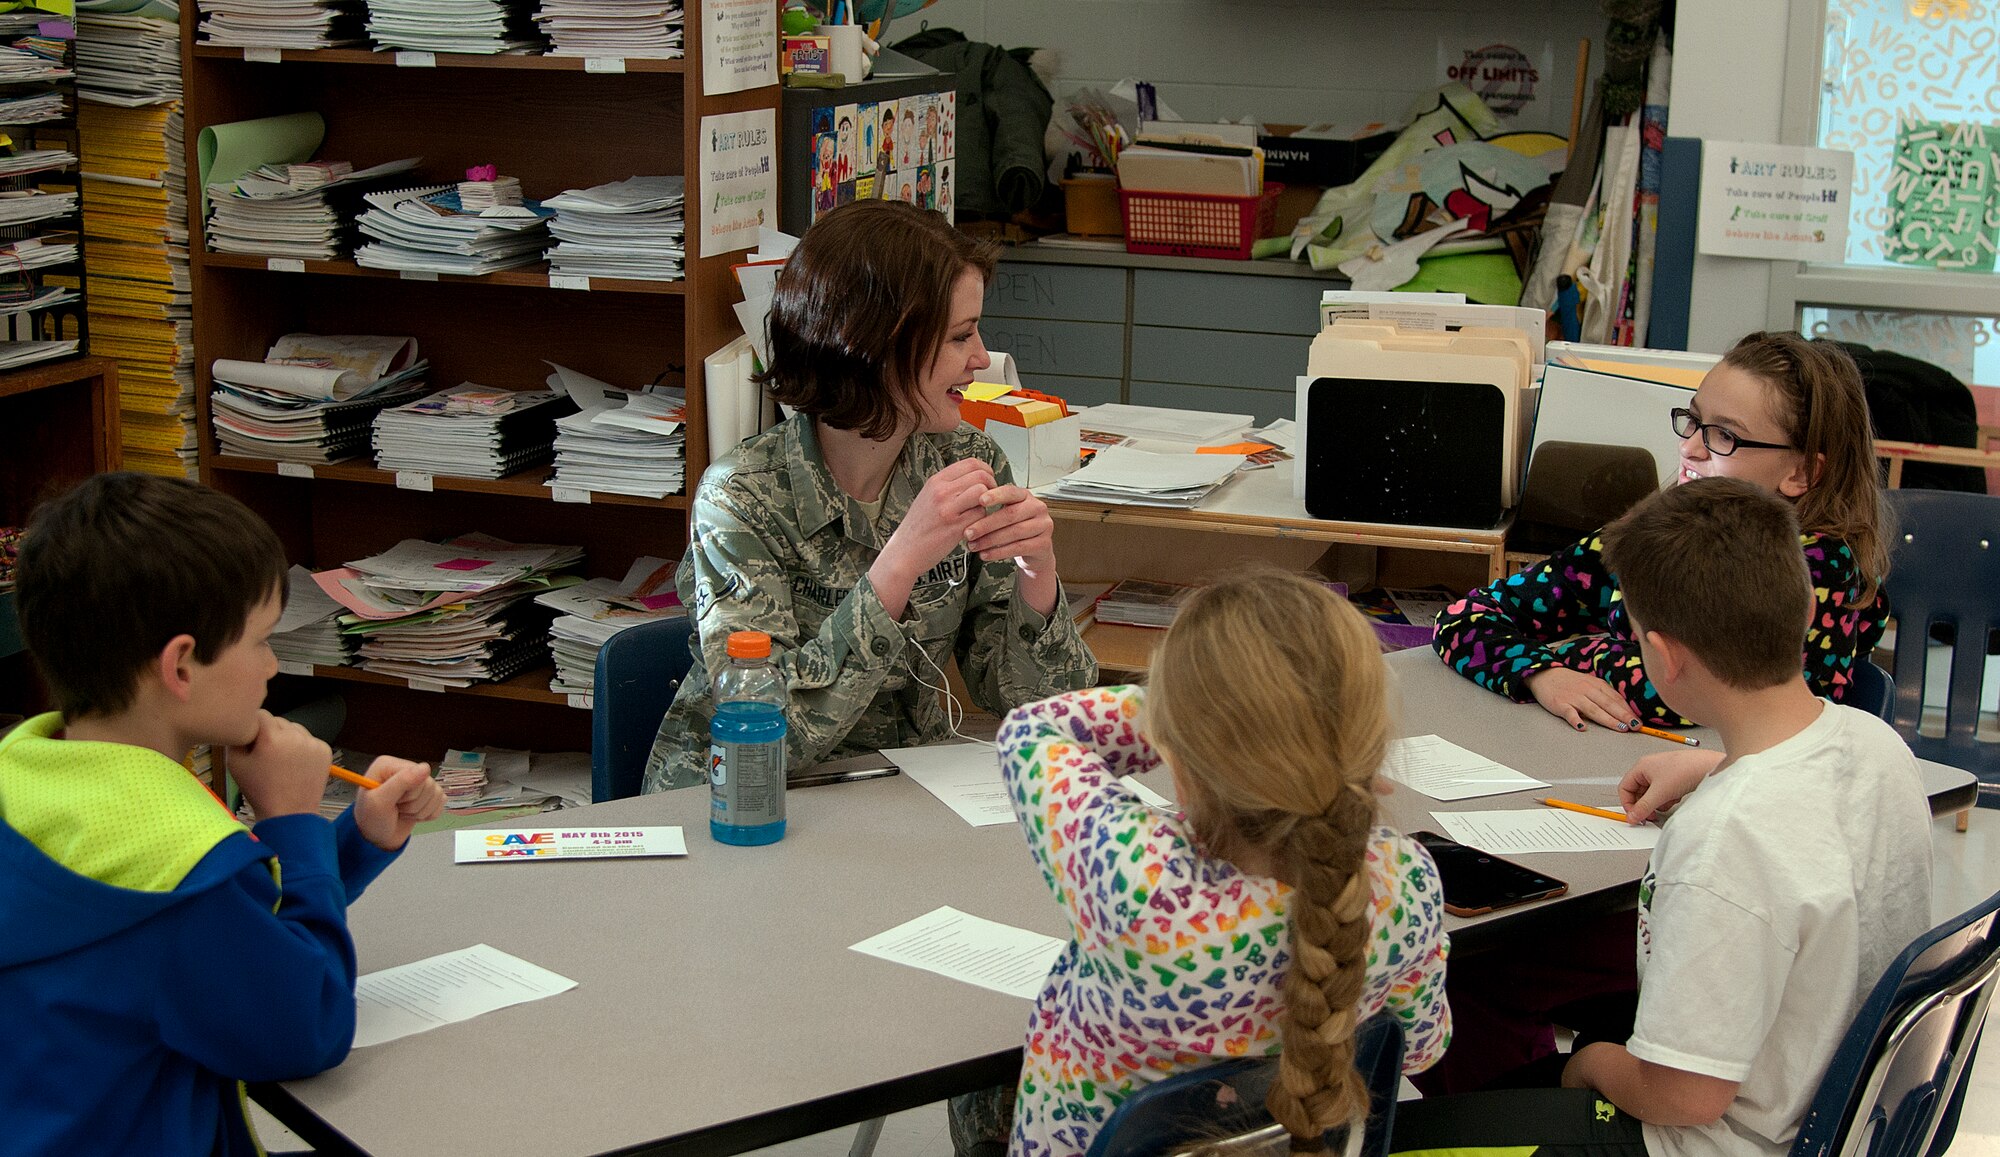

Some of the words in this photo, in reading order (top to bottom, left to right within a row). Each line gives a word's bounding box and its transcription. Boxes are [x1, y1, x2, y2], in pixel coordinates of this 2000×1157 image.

[792, 49, 825, 60] ARTIST
[1447, 65, 1477, 80] OFF
[1483, 67, 1539, 82] LIMITS
[719, 131, 736, 151] ART
[738, 128, 767, 148] RULES
[710, 170, 725, 182] Take
[1741, 160, 1776, 176] ART
[1780, 164, 1837, 180] RULES
[1726, 187, 1748, 197] Take
[1752, 190, 1772, 199] care
[1775, 190, 1785, 199] of
[1788, 191, 1820, 203] People
[929, 562, 953, 582] AIR
[485, 832, 555, 845] SAVE
[486, 847, 557, 857] DATE
